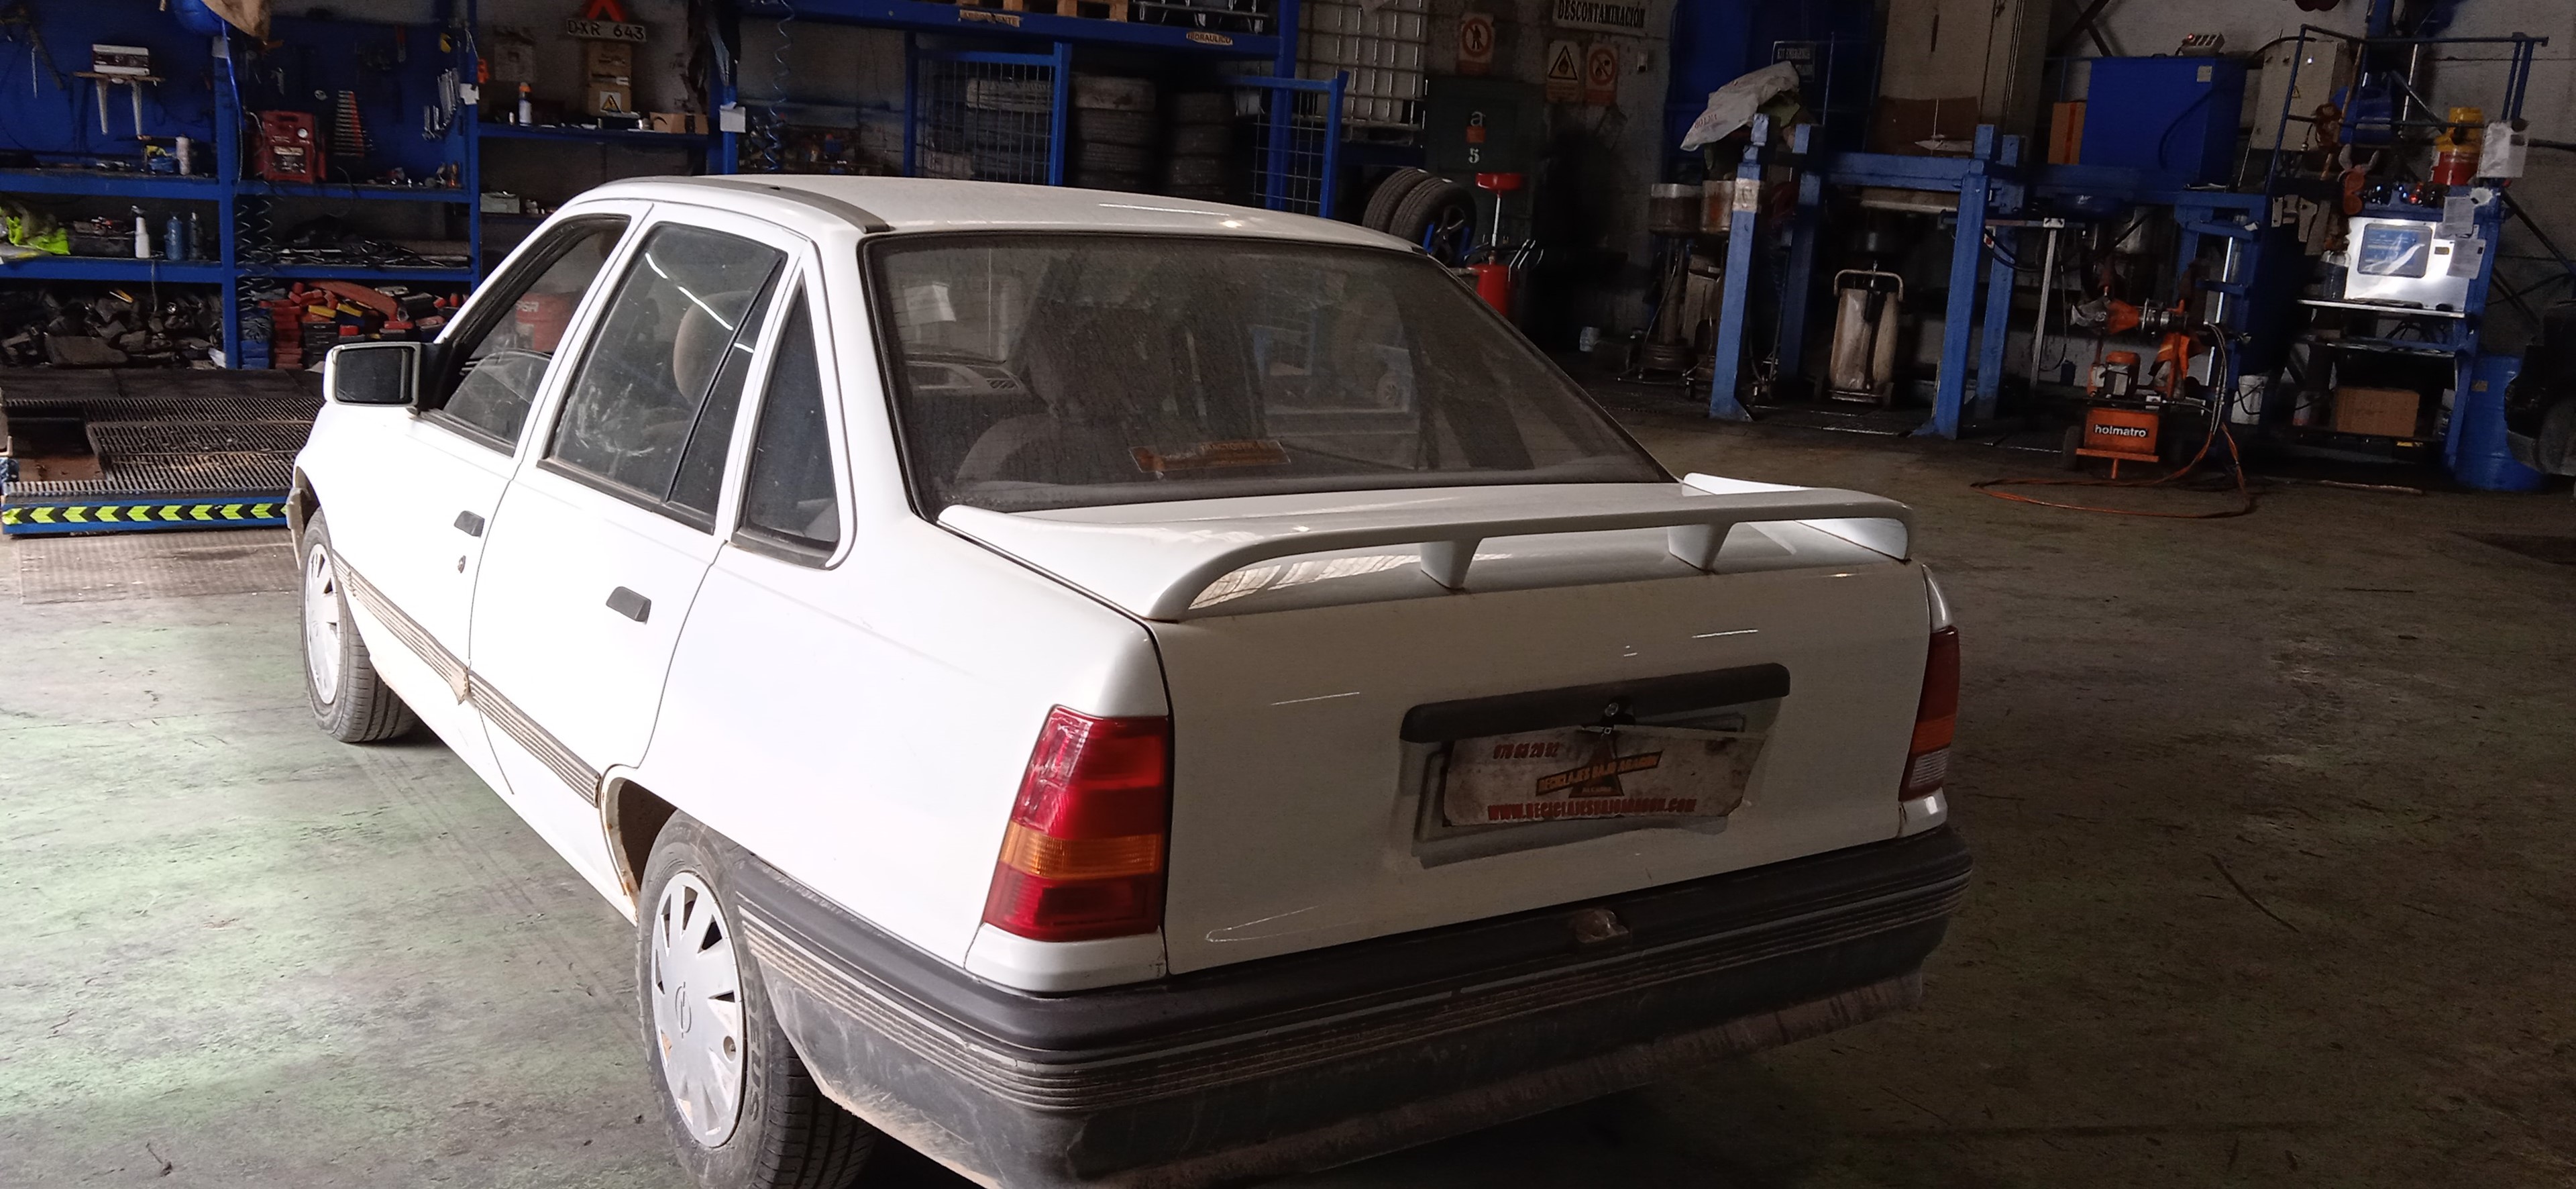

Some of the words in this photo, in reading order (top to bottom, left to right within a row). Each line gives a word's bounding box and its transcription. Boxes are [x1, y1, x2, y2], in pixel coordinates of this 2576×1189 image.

[614, 24, 644, 40] 643
[1468, 147, 1481, 164] 5
[2094, 424, 2147, 437] holmatro
